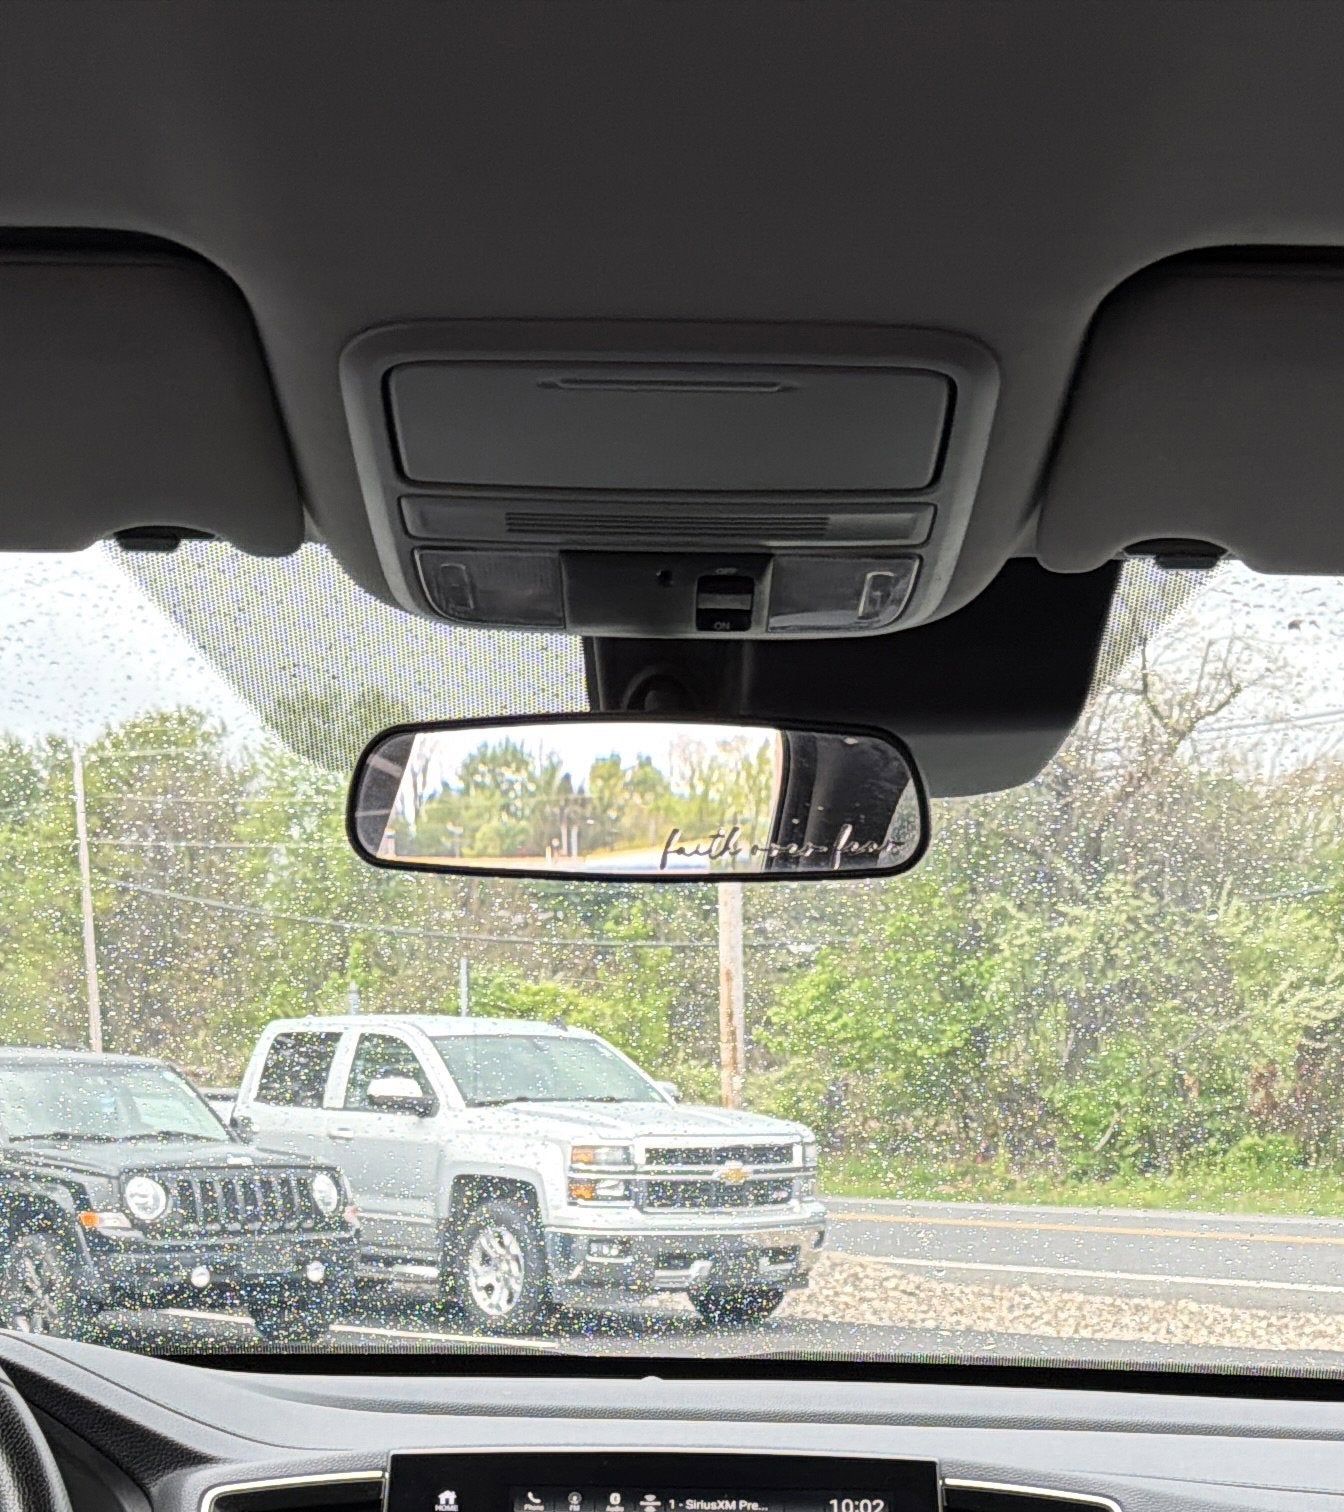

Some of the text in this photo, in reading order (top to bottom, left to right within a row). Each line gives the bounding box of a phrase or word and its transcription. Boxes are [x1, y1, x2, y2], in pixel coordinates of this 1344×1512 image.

[714, 621, 731, 631] ON
[434, 1504, 459, 1512] HOME
[523, 1504, 545, 1512] Phone
[685, 1499, 737, 1511] SiriusXM
[739, 1500, 769, 1512] Pre...
